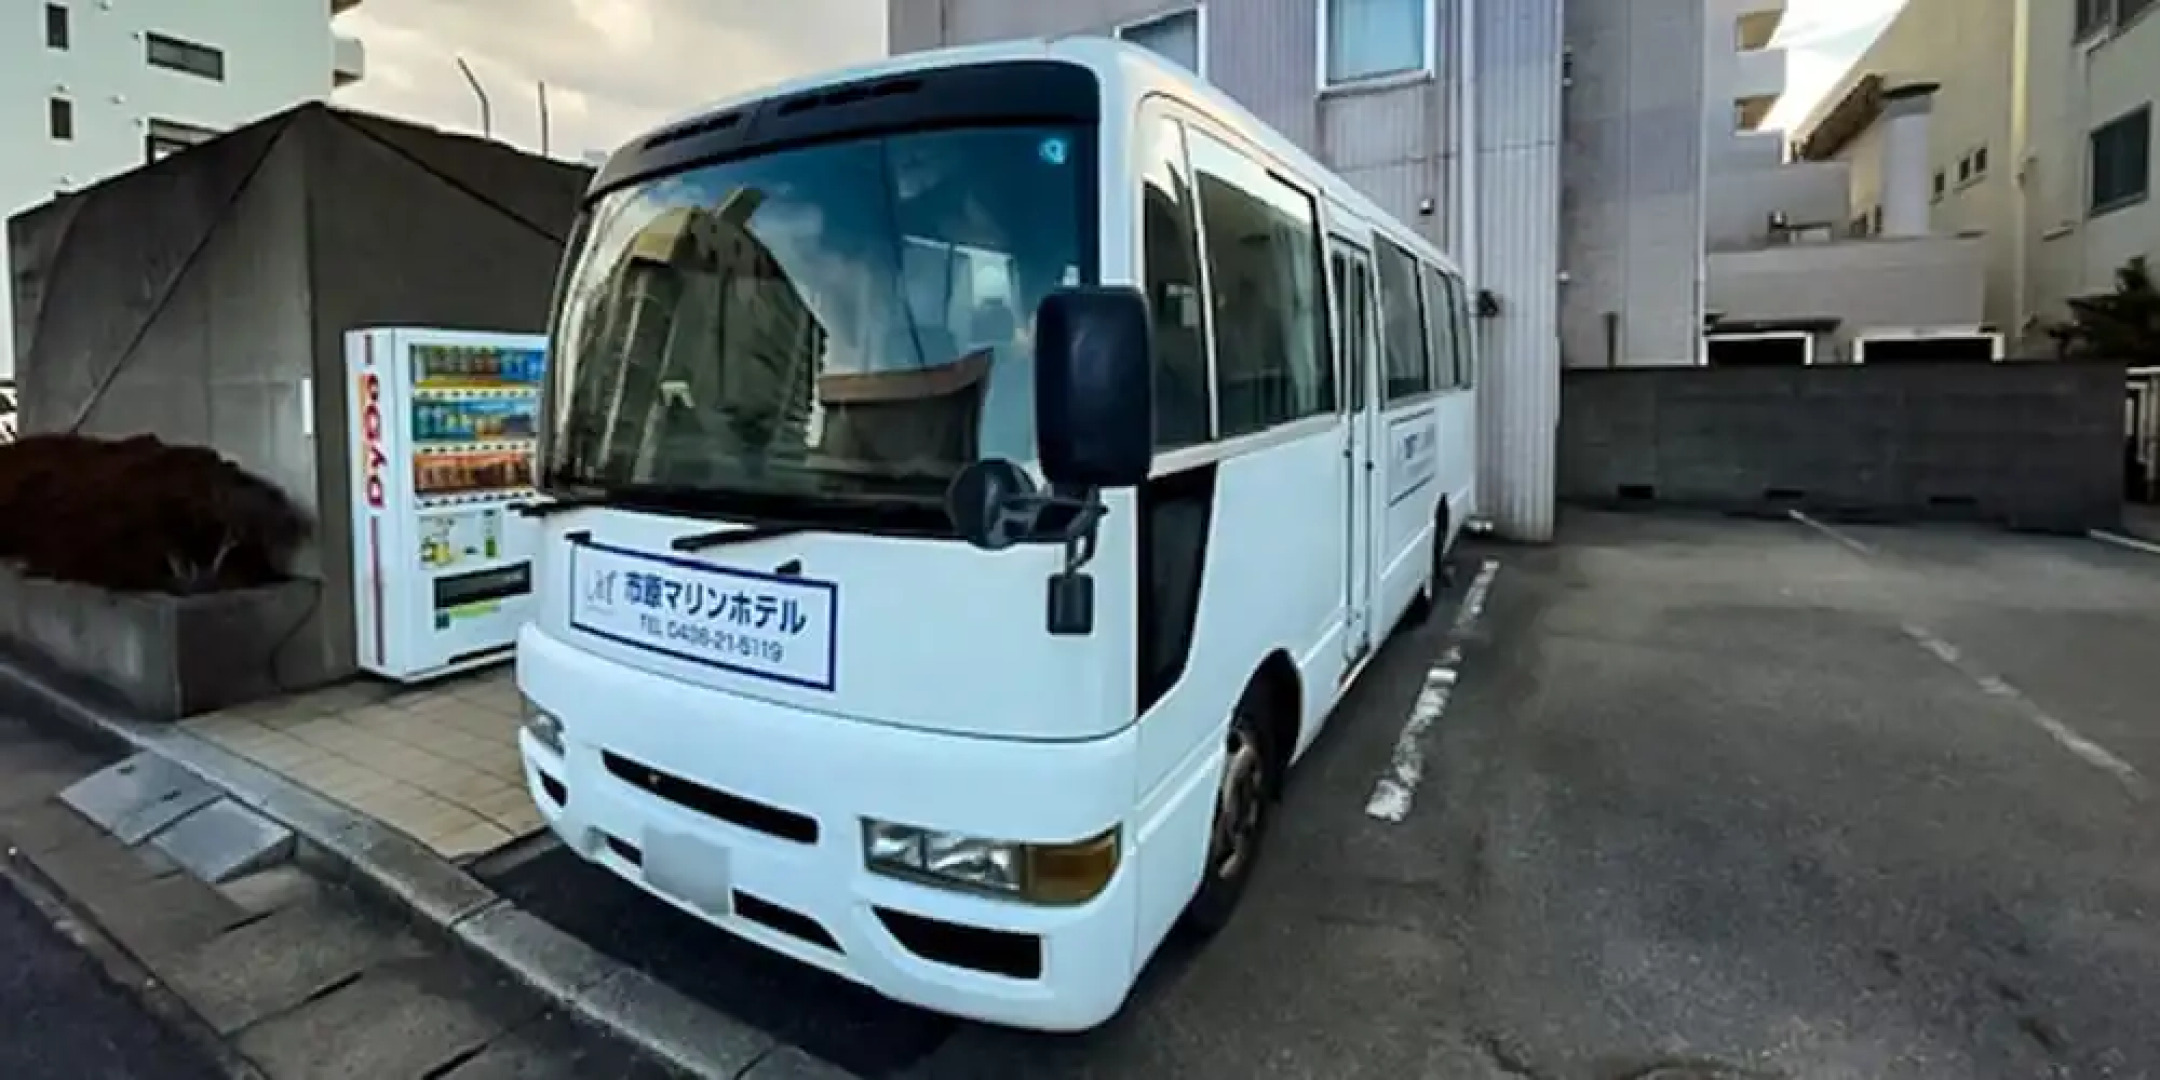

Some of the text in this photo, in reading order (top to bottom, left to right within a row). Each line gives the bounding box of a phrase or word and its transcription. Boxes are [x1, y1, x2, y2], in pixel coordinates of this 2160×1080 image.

[624, 571, 806, 634] 市原マリンホテル
[641, 612, 663, 636] TEL
